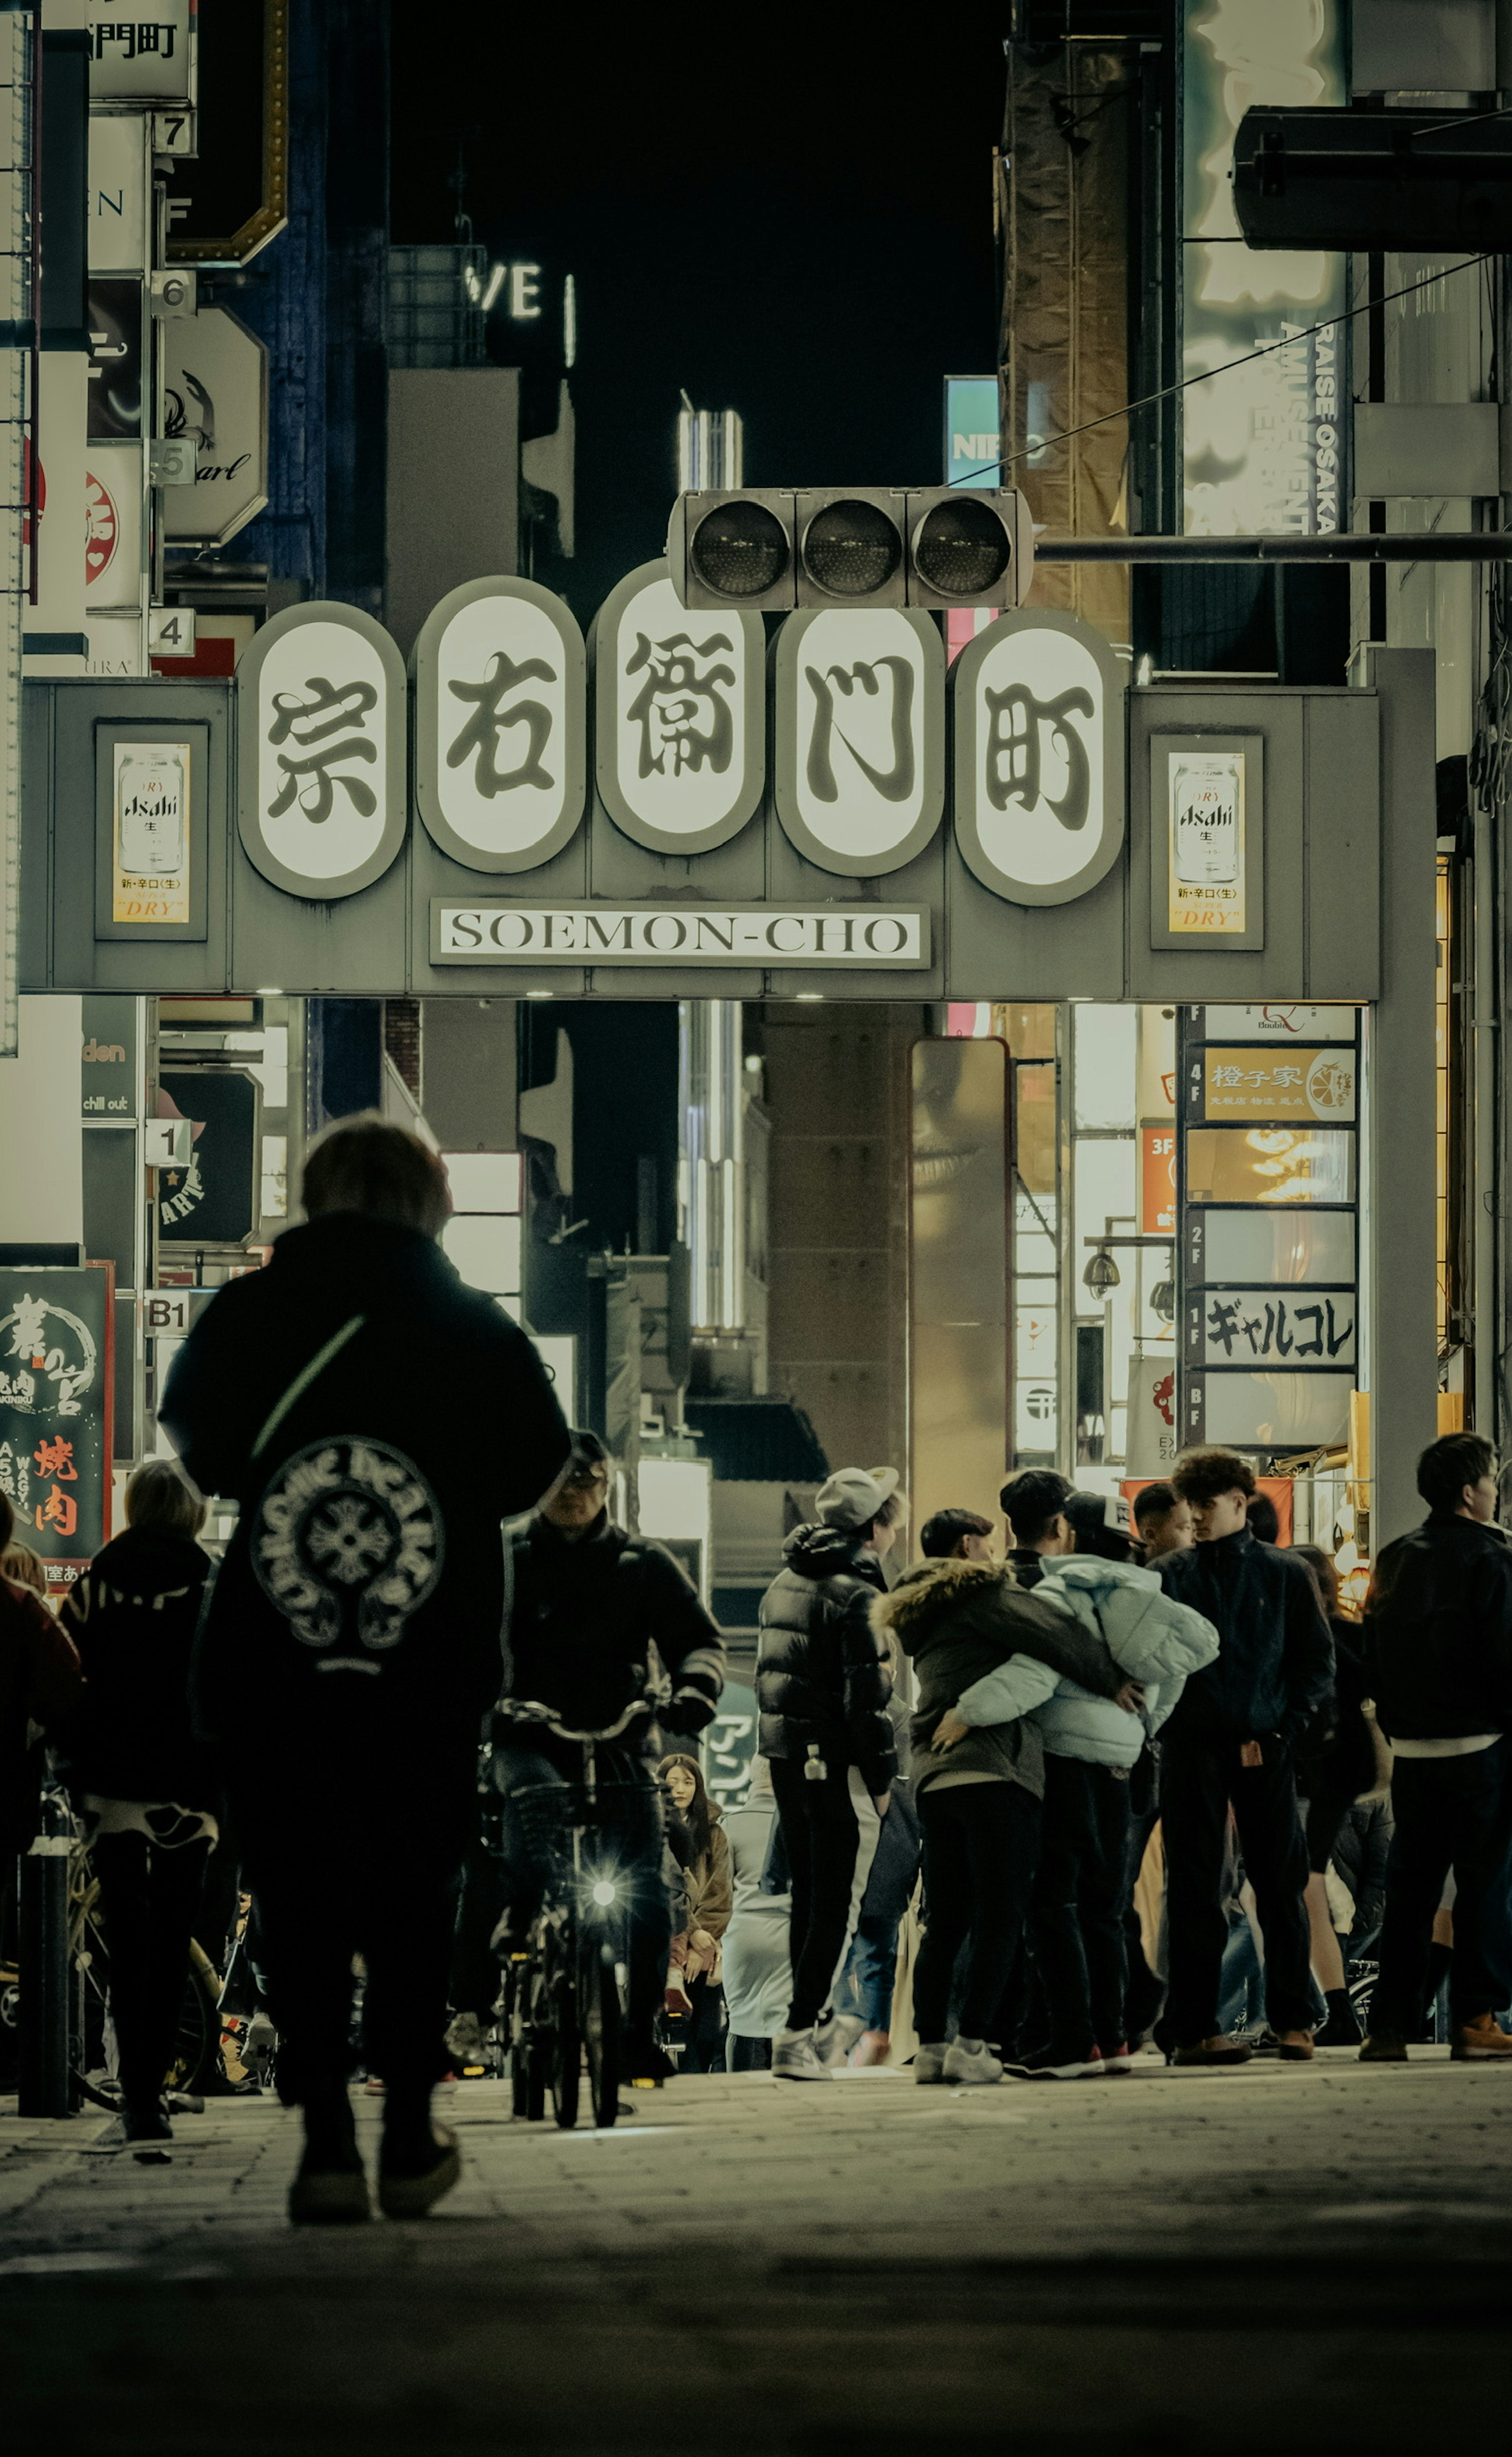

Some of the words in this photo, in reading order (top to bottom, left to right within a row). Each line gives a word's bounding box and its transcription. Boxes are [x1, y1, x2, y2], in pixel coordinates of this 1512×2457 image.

[90, 23, 177, 59] 門町
[164, 118, 184, 146] 7
[87, 189, 123, 216] N
[163, 279, 184, 306] 6
[1316, 322, 1335, 415] RAISE
[1280, 321, 1309, 535] AMUSEMENT
[163, 447, 183, 476] 5
[1316, 424, 1336, 535] OSAKA
[160, 616, 182, 645] 4
[125, 795, 177, 817] Asahi
[1180, 804, 1232, 827] Asahi
[145, 821, 157, 831] 生
[1200, 831, 1212, 841] 生
[451, 913, 908, 953] SOEMON-CHO
[1211, 1065, 1304, 1088] 橙子家
[83, 1097, 105, 1110] chill
[107, 1097, 128, 1110] out
[160, 1128, 174, 1156] 1
[1152, 1139, 1173, 1155] 3F
[1192, 1227, 1201, 1264] 2F
[148, 1299, 184, 1328] B1
[1190, 1308, 1199, 1344] 1F
[1206, 1298, 1353, 1358] ギャルコレ
[33, 1435, 78, 1536] 焼肉
